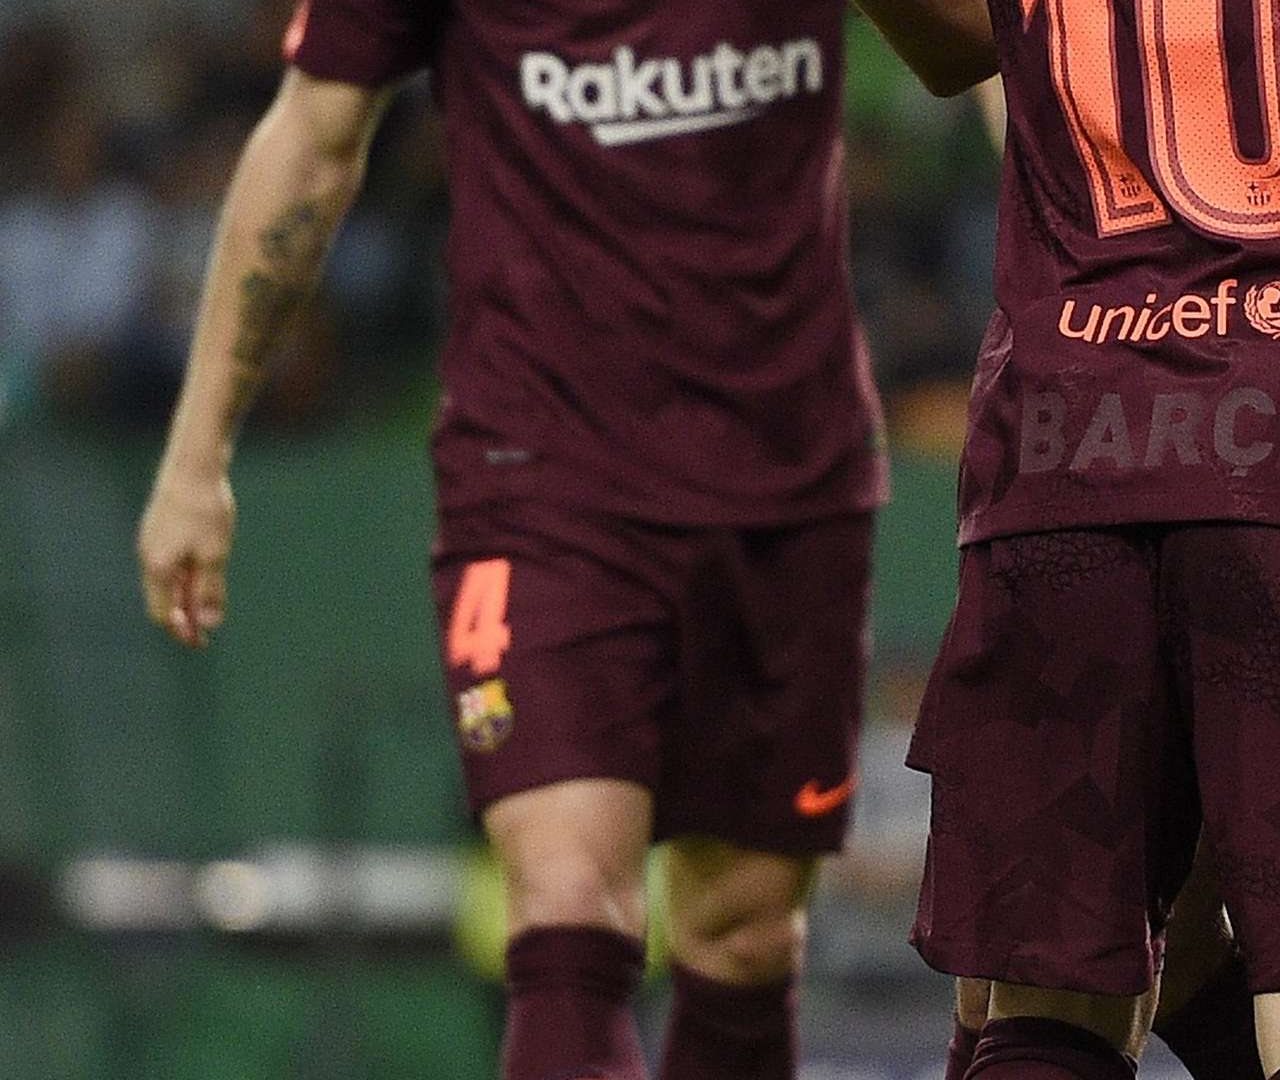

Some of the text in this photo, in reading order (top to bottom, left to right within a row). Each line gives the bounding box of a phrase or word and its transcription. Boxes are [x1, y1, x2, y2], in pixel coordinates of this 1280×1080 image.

[520, 39, 822, 123] Rakuten
[1058, 279, 1238, 344] unicef
[447, 557, 513, 675] 4
